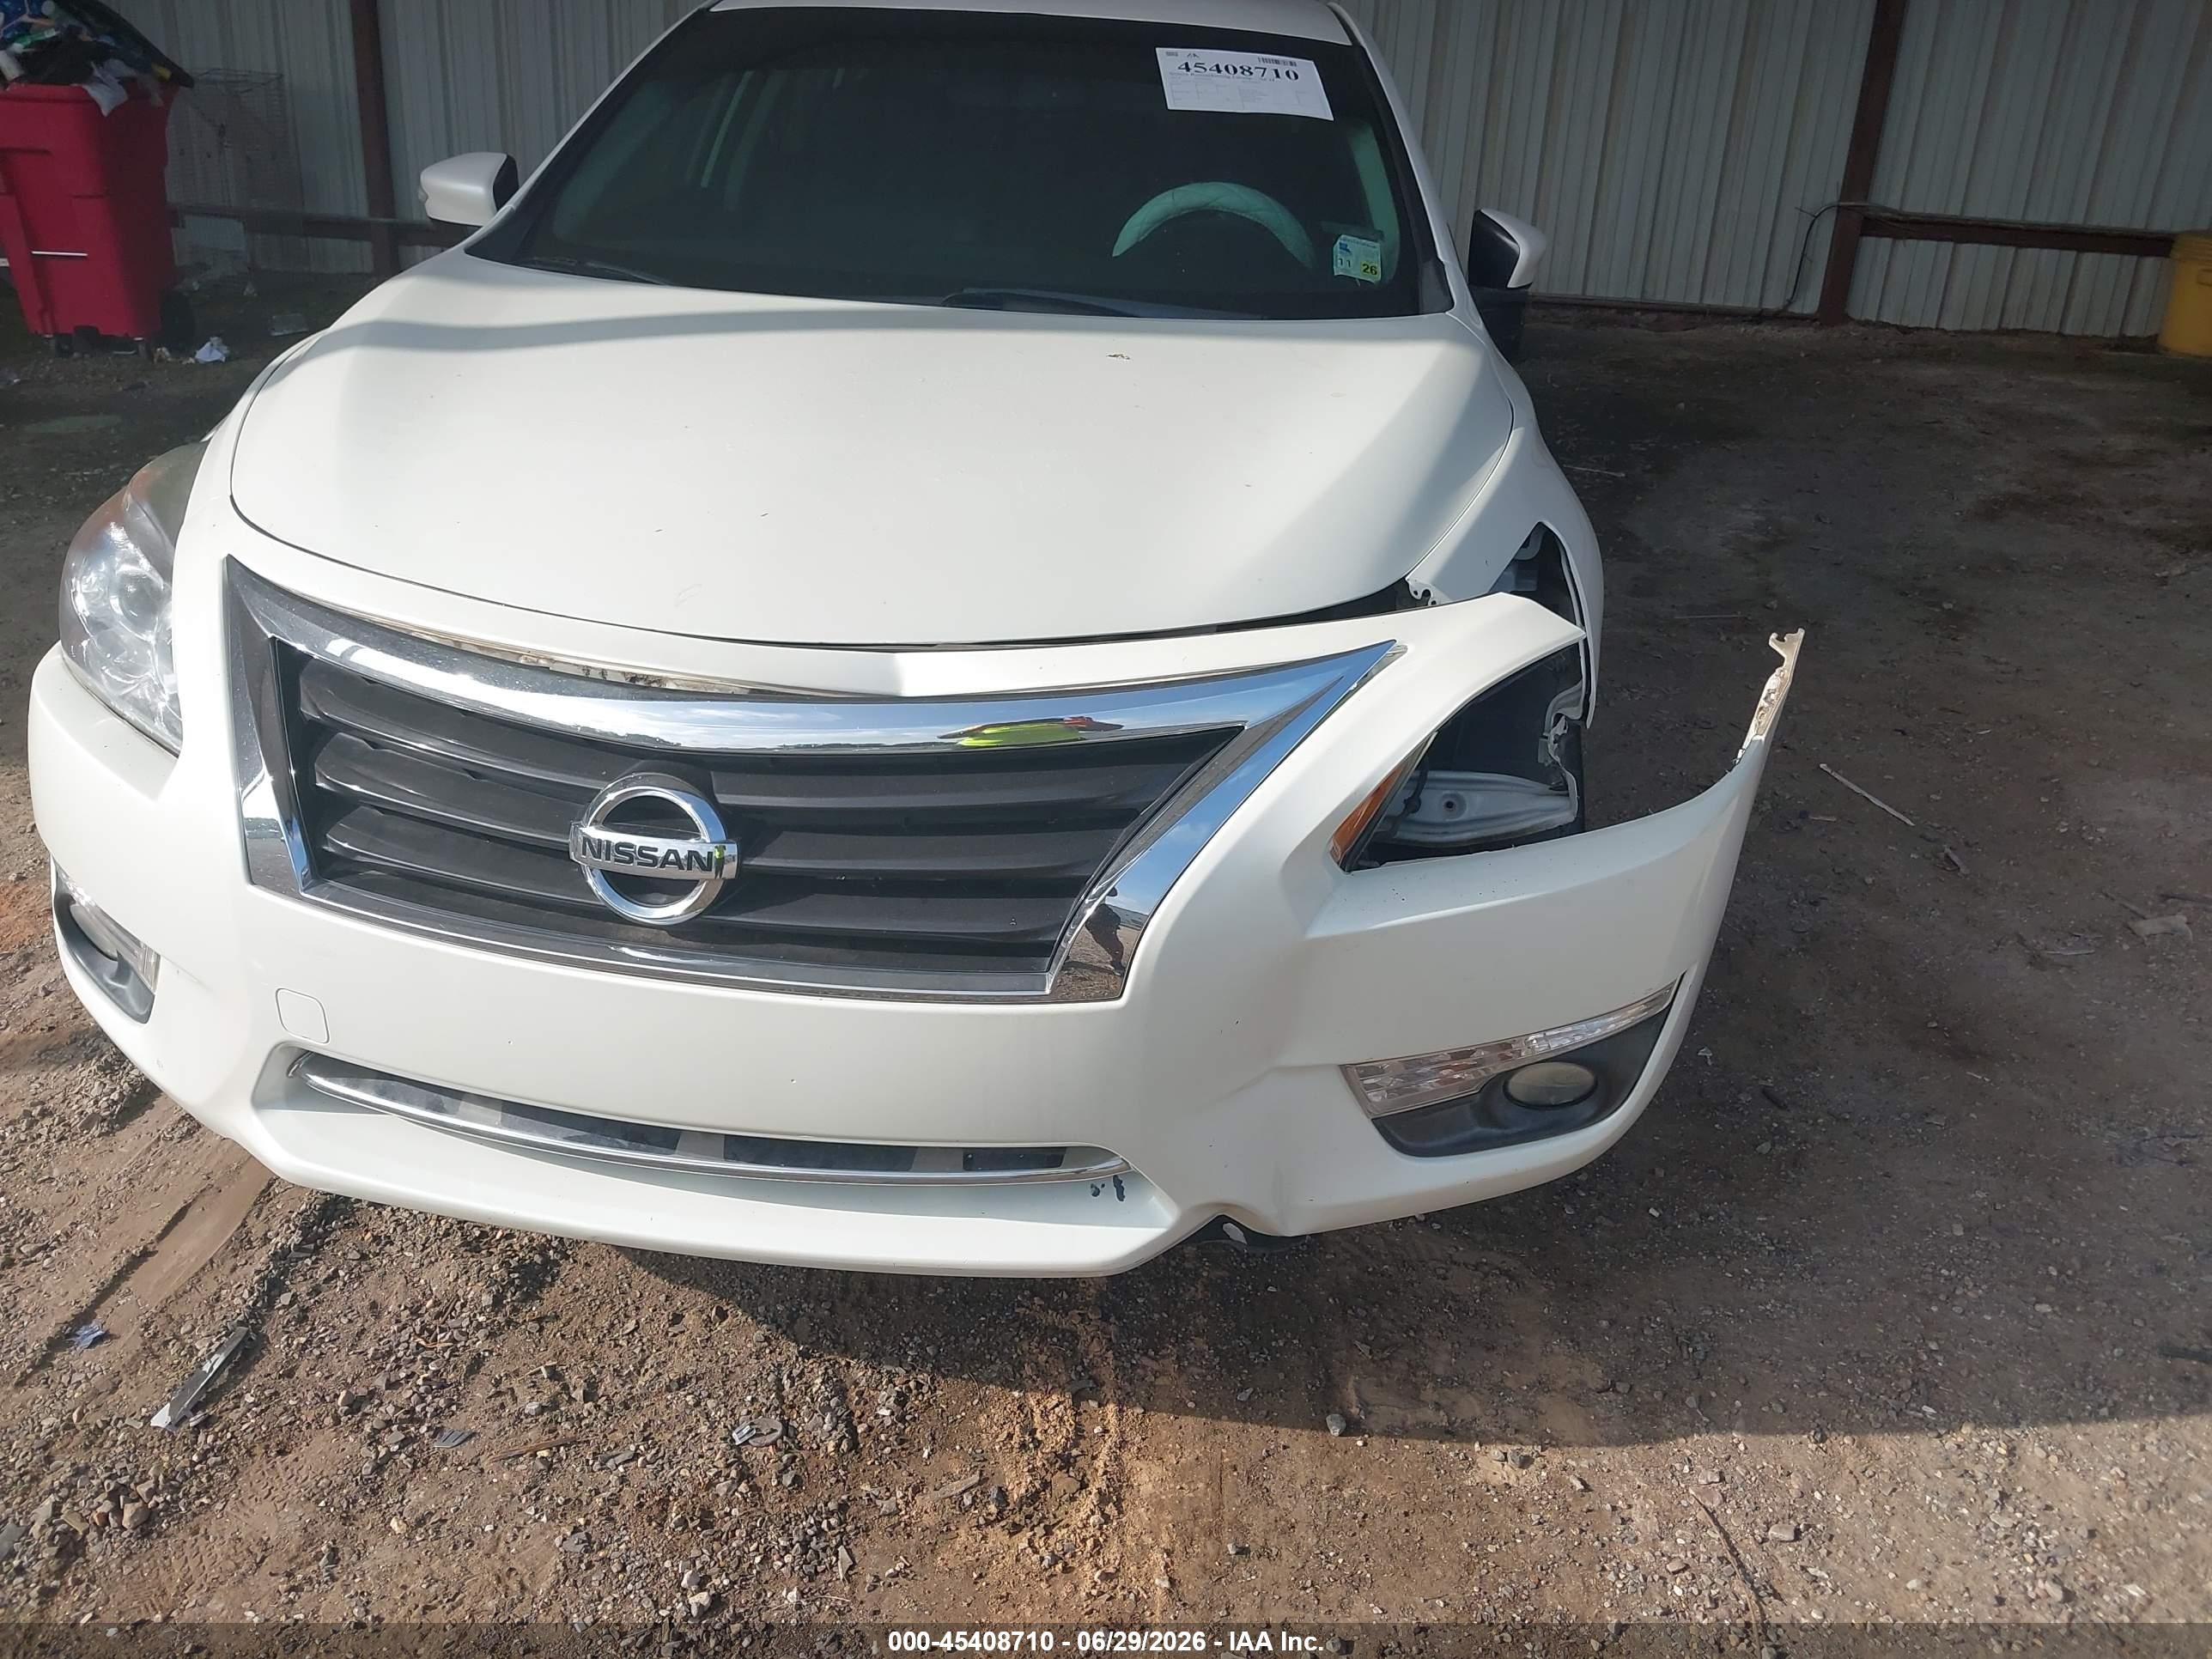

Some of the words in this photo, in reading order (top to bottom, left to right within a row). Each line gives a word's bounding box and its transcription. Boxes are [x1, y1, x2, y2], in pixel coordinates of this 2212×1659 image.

[1177, 61, 1299, 81] 45408710
[1362, 263, 1377, 276] 26
[581, 838, 714, 872] NISSAN
